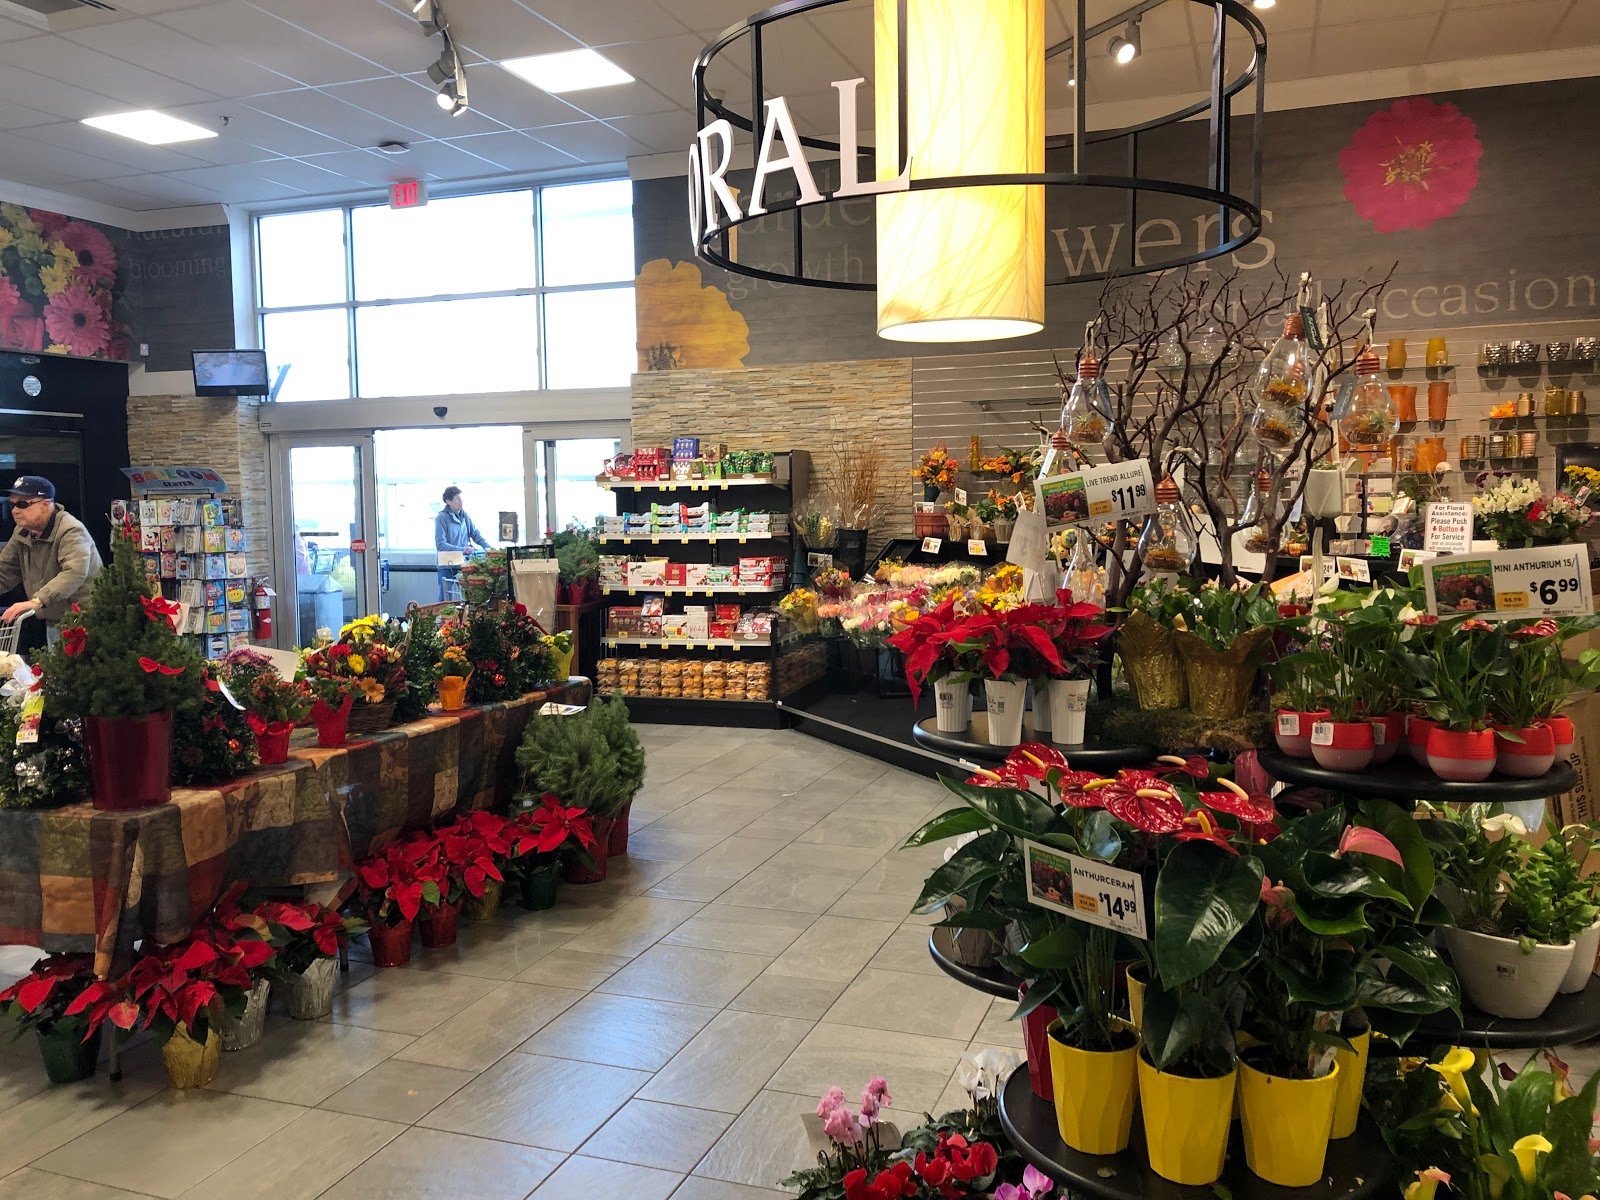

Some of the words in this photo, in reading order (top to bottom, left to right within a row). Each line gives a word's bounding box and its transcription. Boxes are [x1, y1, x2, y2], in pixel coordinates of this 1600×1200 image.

[688, 77, 913, 256] ORAL
[394, 181, 418, 207] EXIT
[128, 253, 226, 279] blooming
[726, 242, 864, 300] growth
[131, 469, 219, 484] BALLOON
[1086, 478, 1098, 487] LIVE
[1100, 475, 1118, 484] TREND
[1120, 470, 1142, 480] ALLURE
[1513, 561, 1562, 571] ANTHURIUM
[1570, 752, 1581, 766] UP
[1575, 768, 1584, 793] SI
[1576, 795, 1587, 819] THIS
[1073, 868, 1134, 890] ANTHURCERAM
